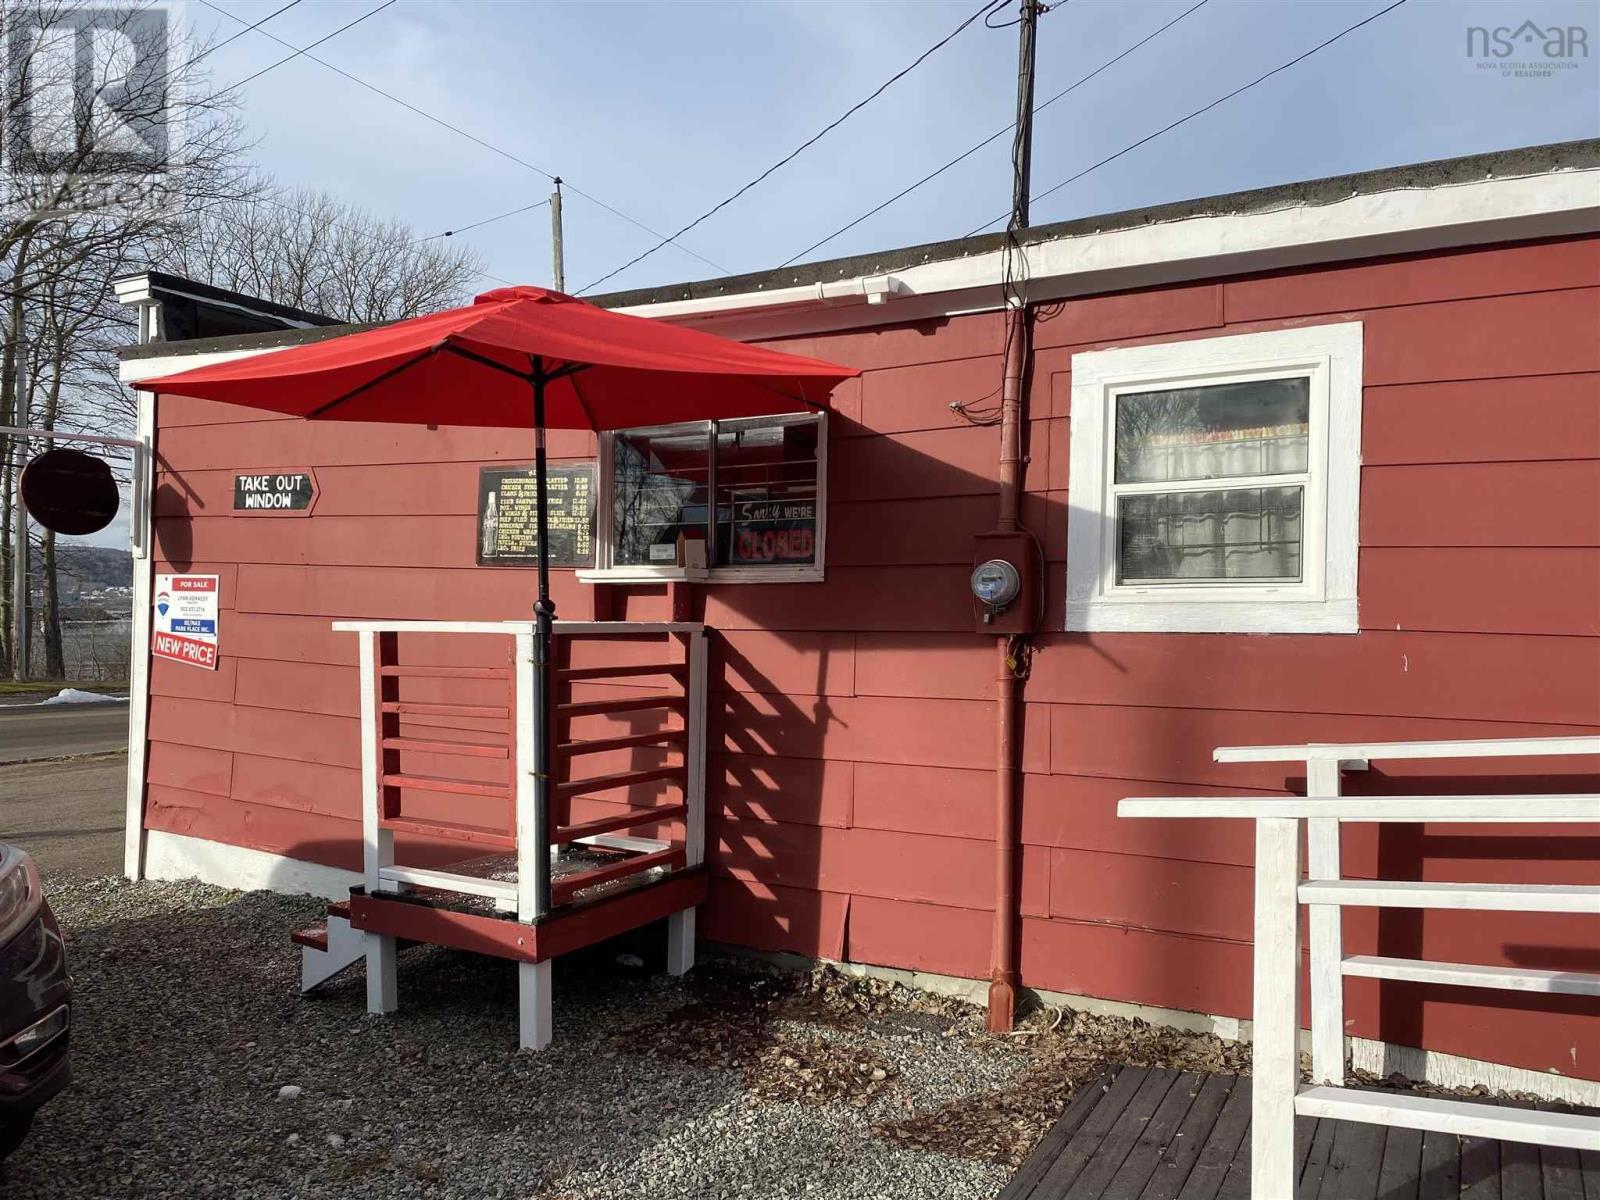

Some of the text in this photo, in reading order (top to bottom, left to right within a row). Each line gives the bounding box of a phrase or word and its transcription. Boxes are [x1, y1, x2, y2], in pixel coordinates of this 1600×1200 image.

[239, 475, 303, 491] TAKE OUT
[245, 492, 292, 508] WINDOW
[736, 528, 816, 560] CLOSED
[156, 636, 215, 664] NEW PRICE
